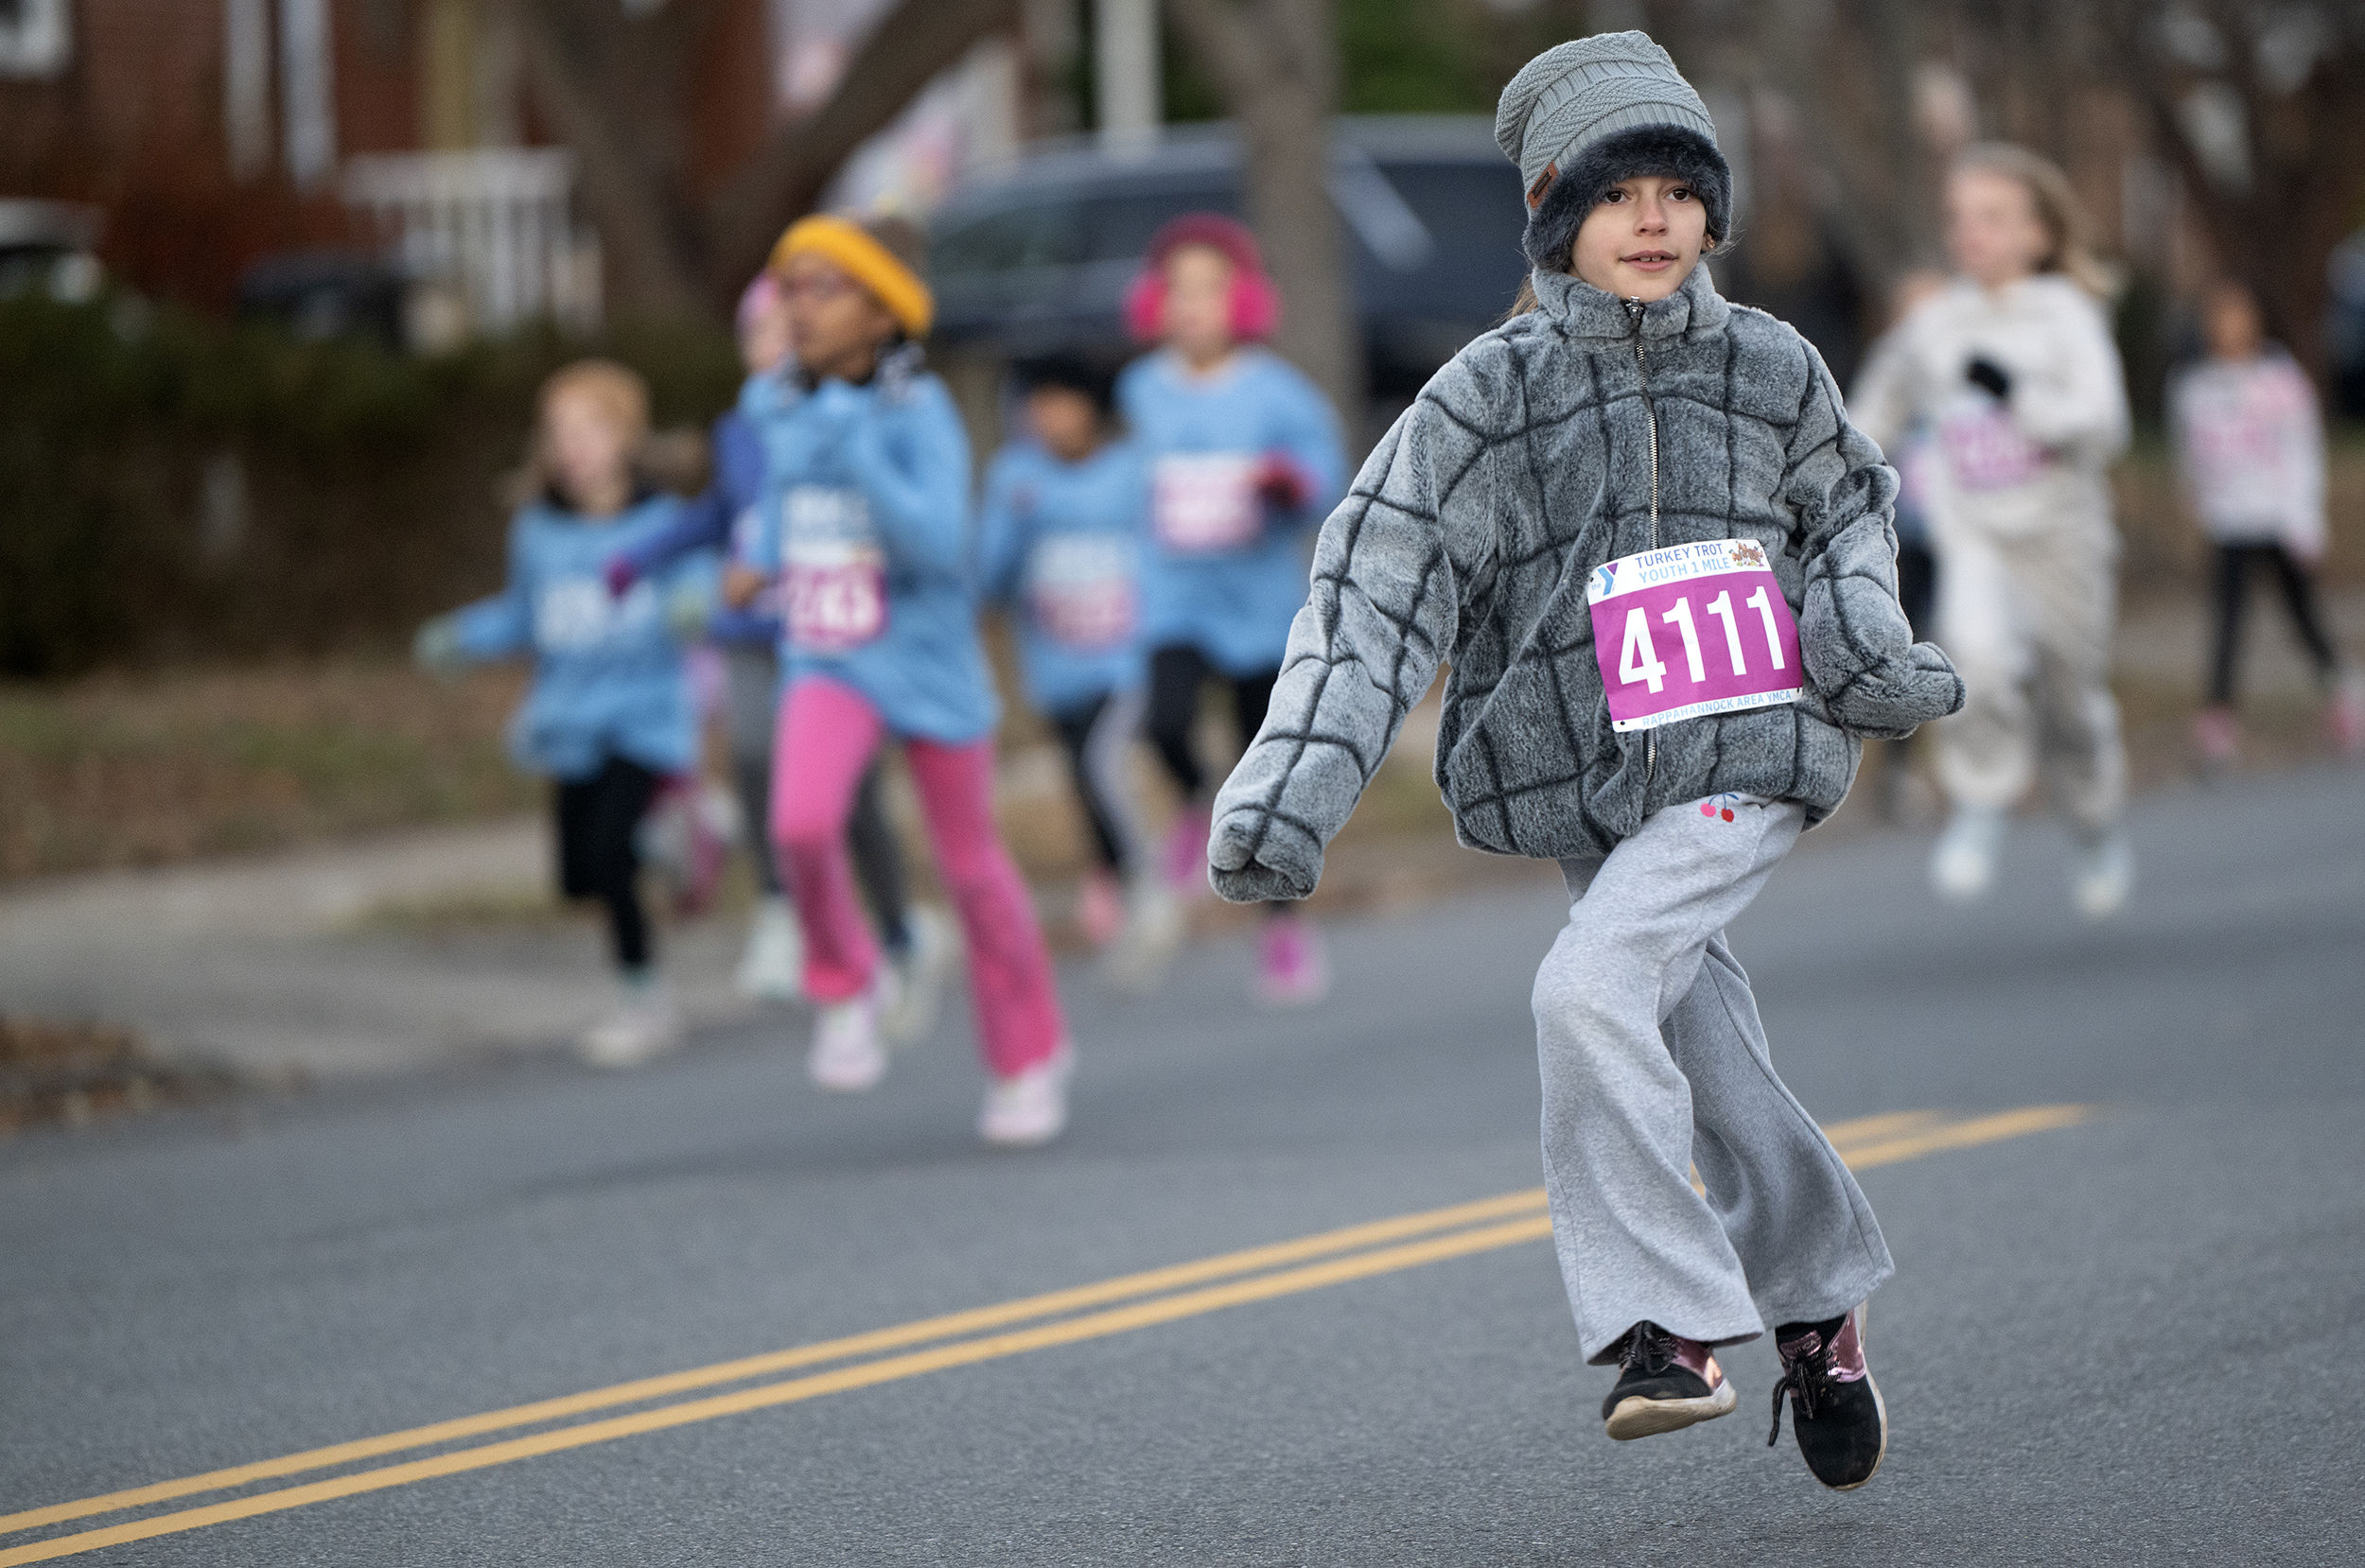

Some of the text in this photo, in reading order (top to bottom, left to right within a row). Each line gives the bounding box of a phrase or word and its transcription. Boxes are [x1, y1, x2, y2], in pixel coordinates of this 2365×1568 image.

[1635, 543, 1723, 568] TURKEY TROT
[1638, 557, 1731, 584] YOUTH 1 MILE
[1619, 585, 1785, 694] 4111
[1642, 689, 1792, 727] RAPPAHANNOCK AREA YMCA
